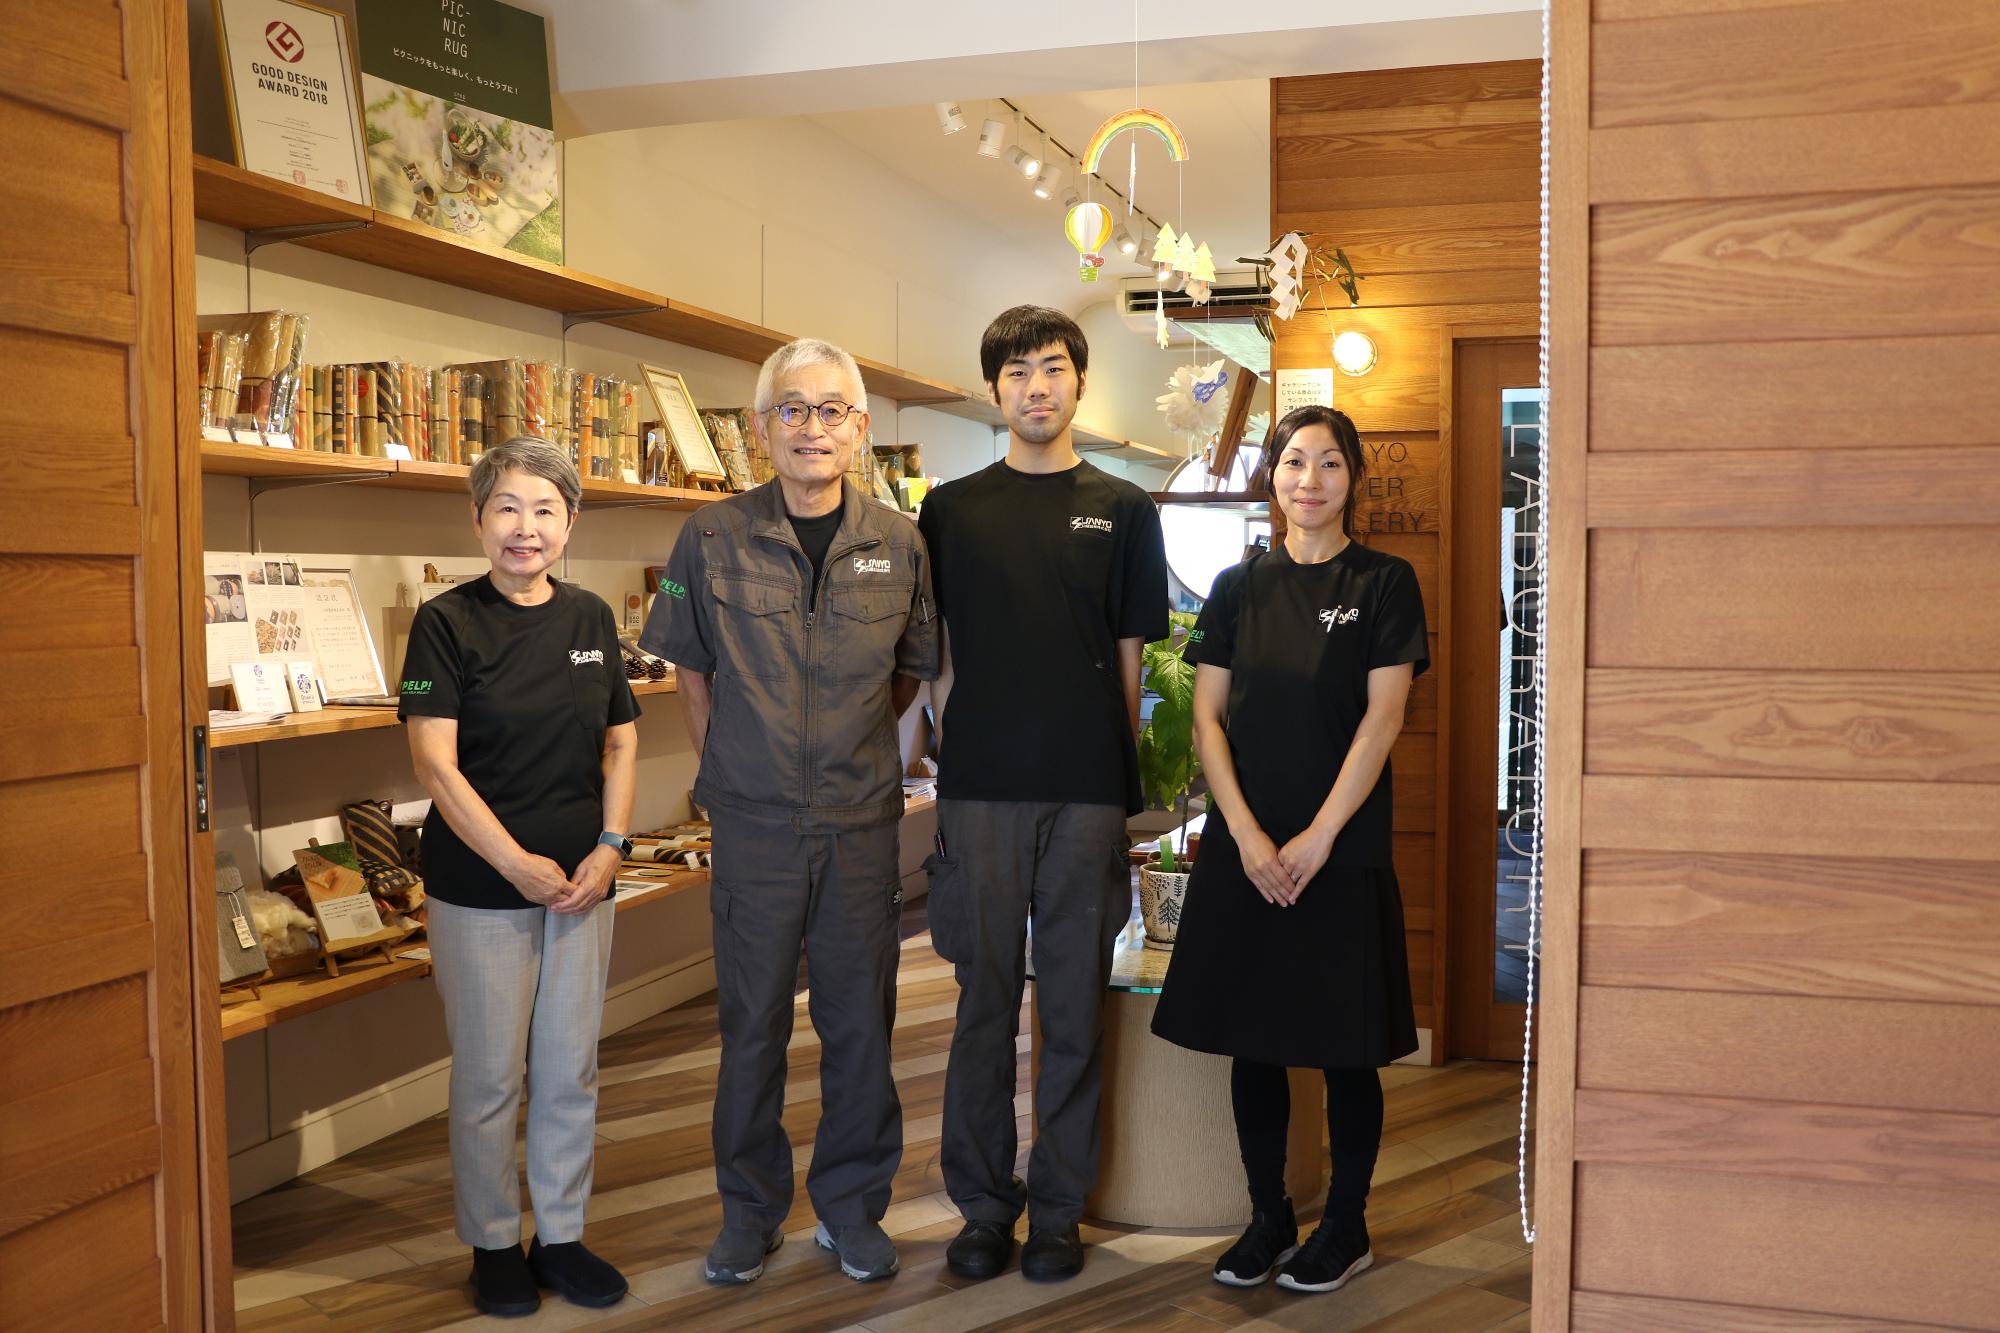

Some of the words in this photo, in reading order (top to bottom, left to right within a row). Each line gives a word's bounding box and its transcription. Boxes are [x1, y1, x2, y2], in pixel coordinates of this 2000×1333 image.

[441, 0, 471, 18] PIC-
[443, 17, 466, 38] NIC
[444, 37, 468, 58] RUG
[251, 62, 284, 80] GOOD
[287, 71, 328, 92] DESIGN
[258, 78, 299, 98] AWARD
[302, 89, 328, 105] 2018
[1362, 442, 1408, 463] YO
[1368, 477, 1404, 498] ER
[1352, 512, 1425, 532] LERY
[401, 680, 433, 691] PELP!
